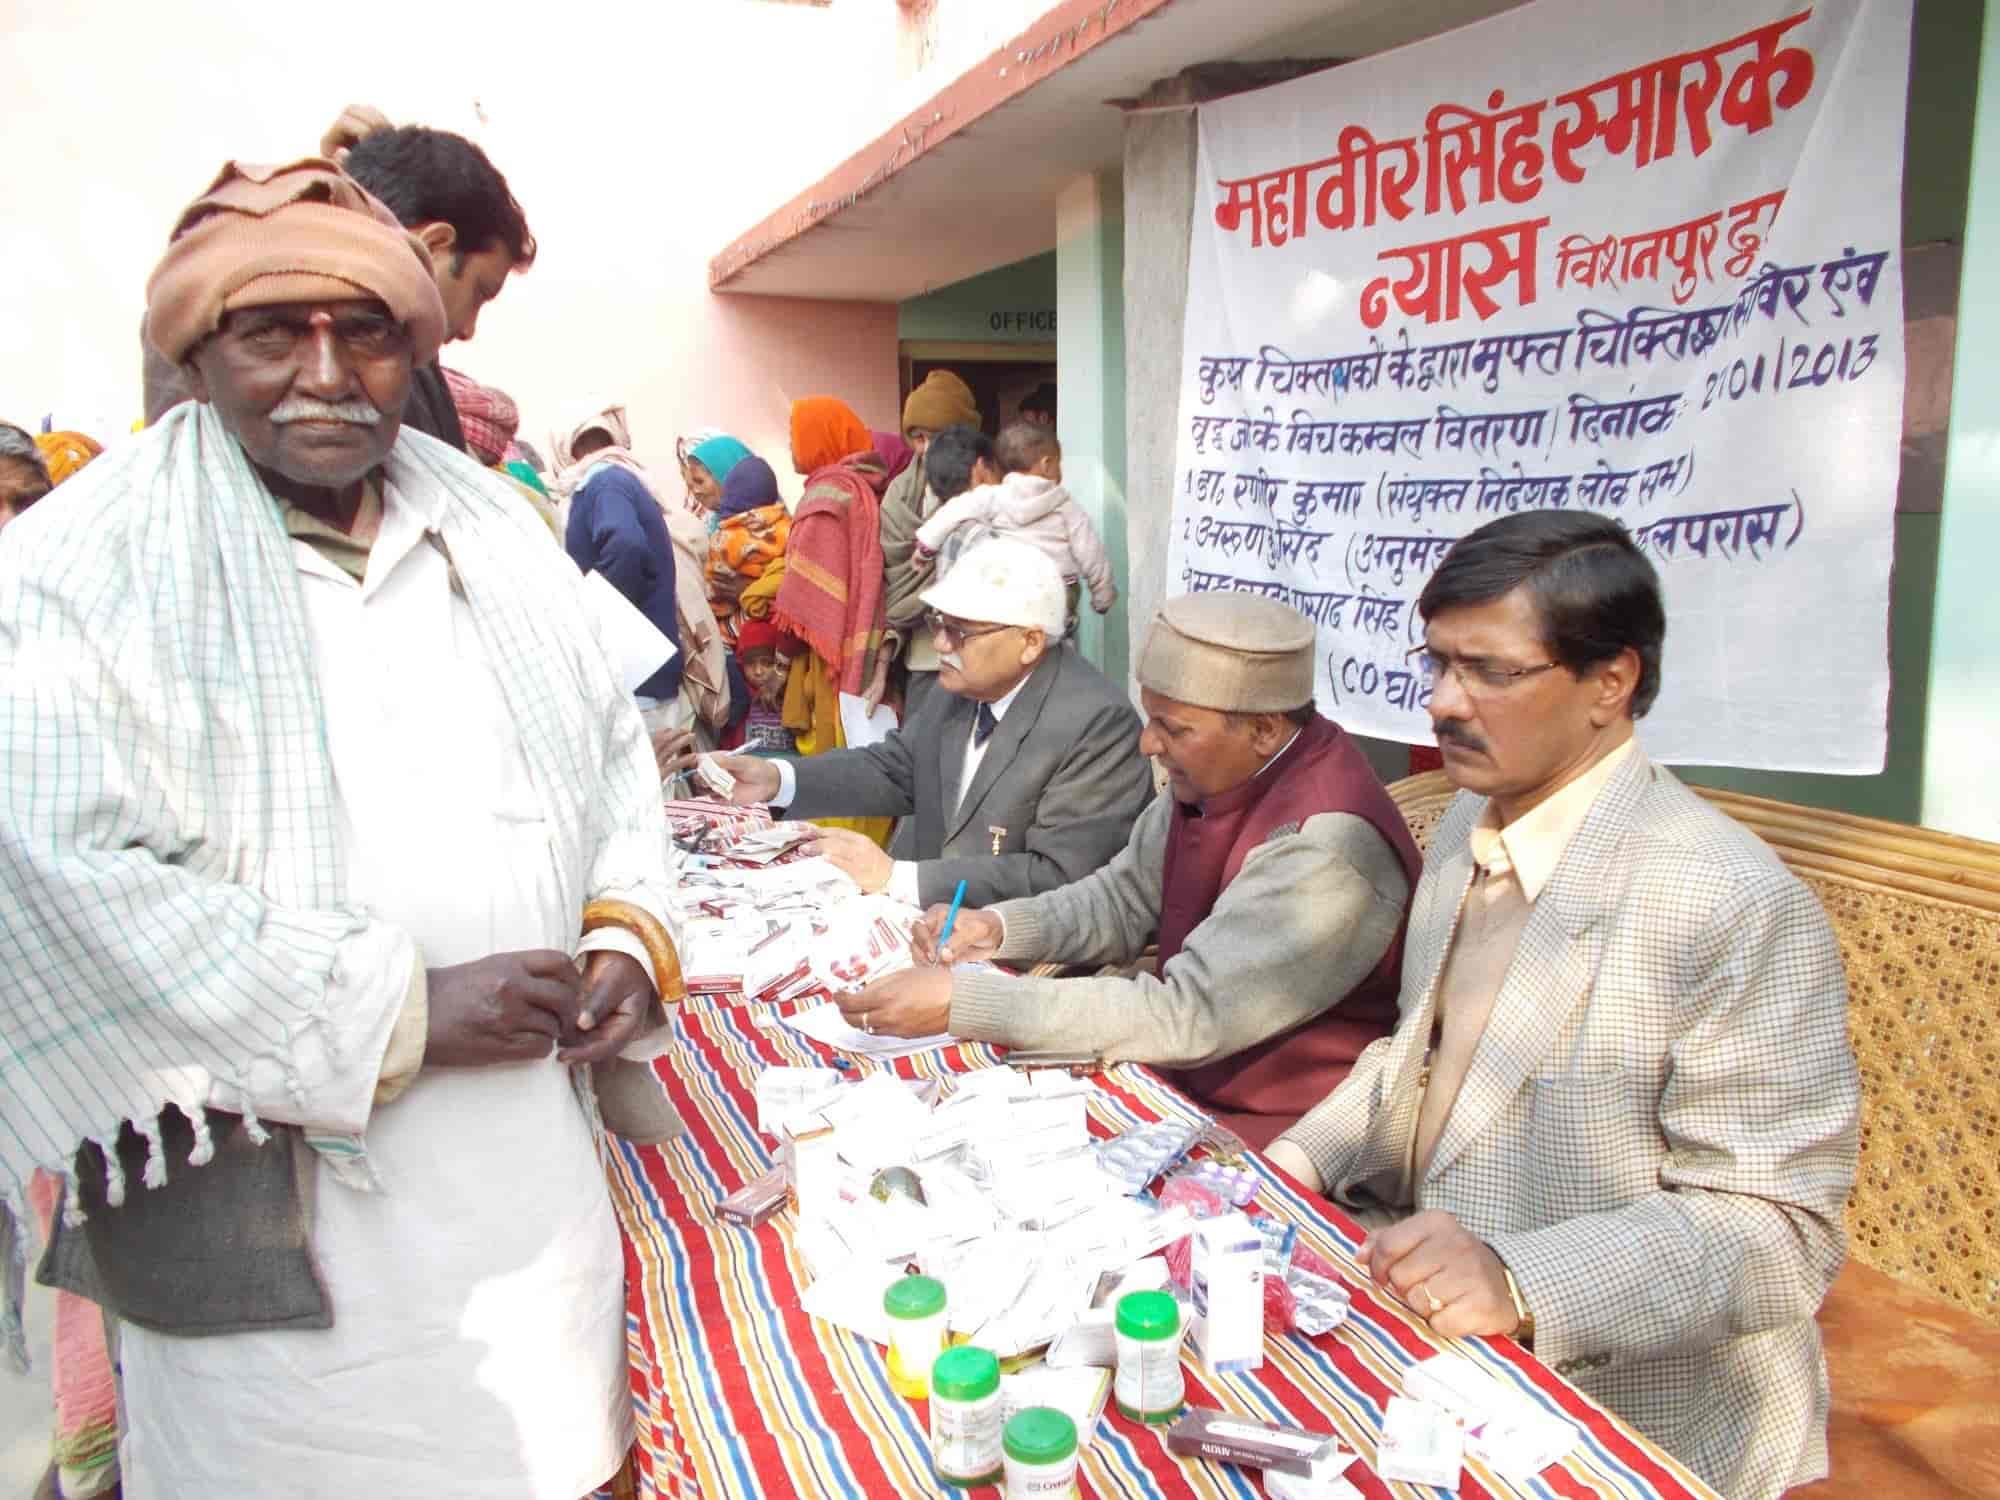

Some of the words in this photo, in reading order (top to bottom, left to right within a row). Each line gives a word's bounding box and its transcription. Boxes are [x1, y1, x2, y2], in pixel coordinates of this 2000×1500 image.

[1551, 9, 1815, 184] स्मारक
[989, 311, 1058, 330] OFFICE
[1360, 217, 1550, 329] न्यास
